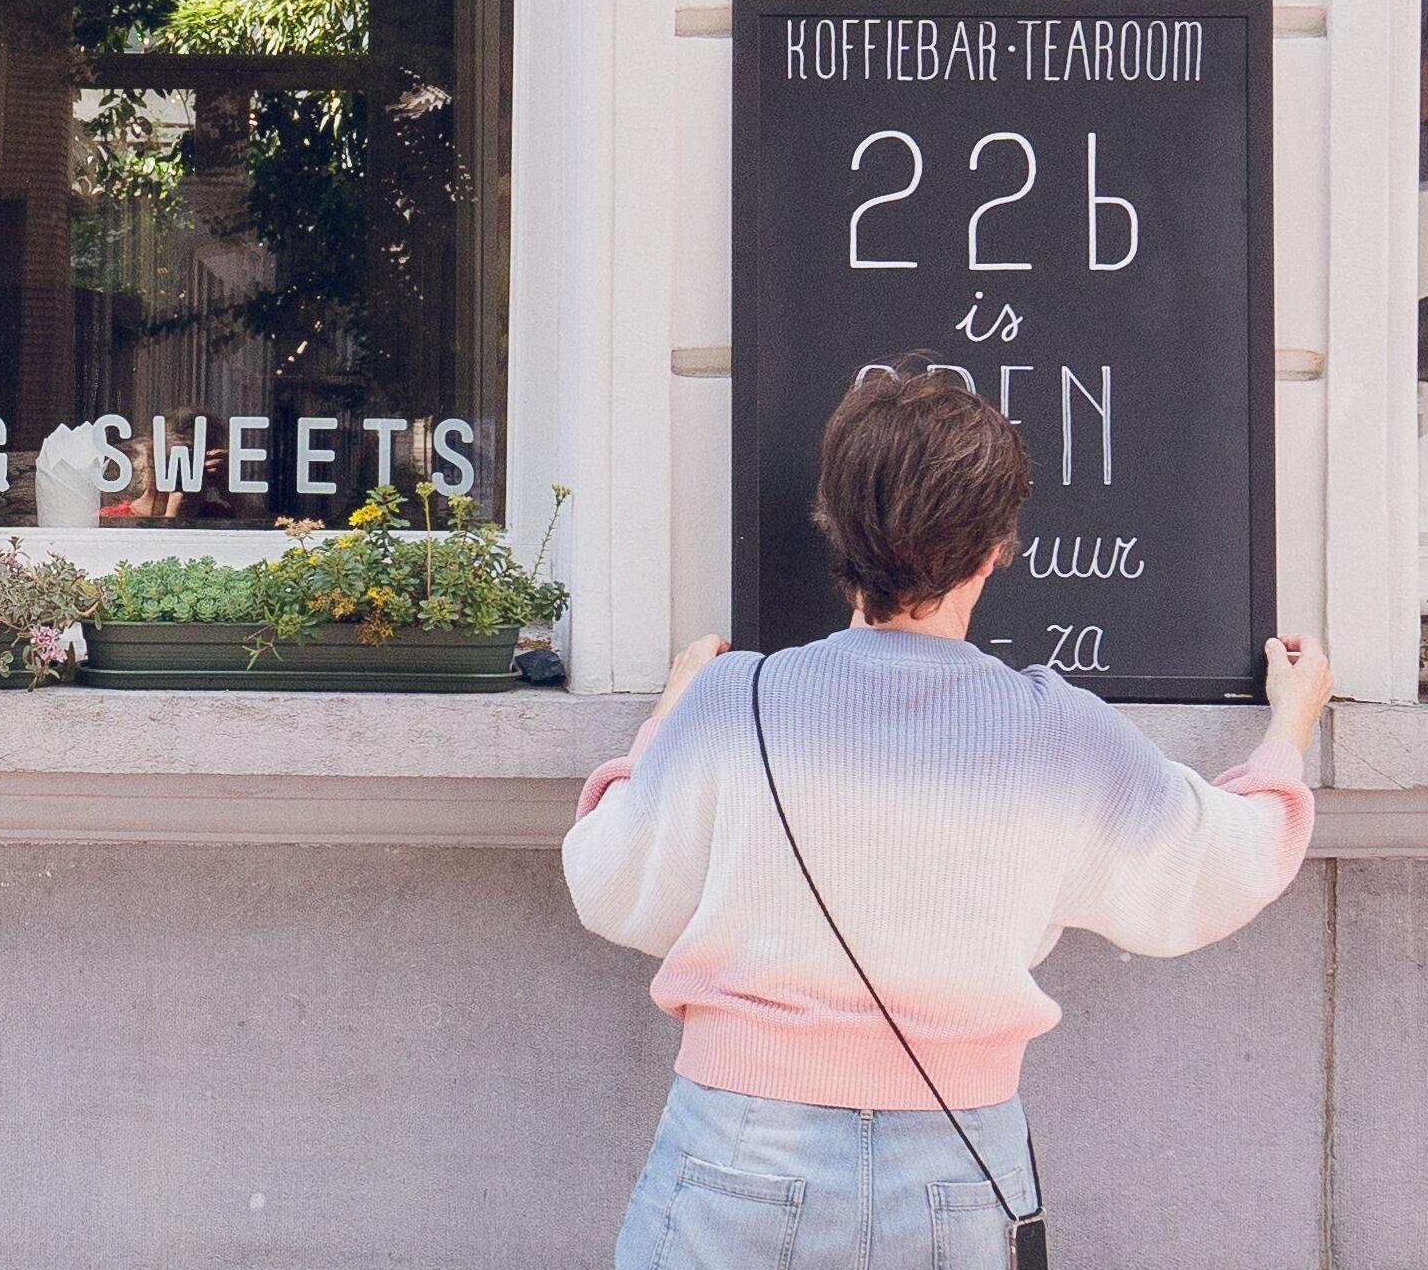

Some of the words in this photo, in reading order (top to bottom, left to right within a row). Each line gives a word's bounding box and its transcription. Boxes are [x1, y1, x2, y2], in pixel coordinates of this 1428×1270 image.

[849, 130, 1140, 272] 22b
[955, 291, 1023, 343] is
[101, 413, 476, 497] SWEETS
[854, 364, 1113, 487] EN
[1022, 533, 1145, 579] uur
[1046, 624, 1111, 672] za
